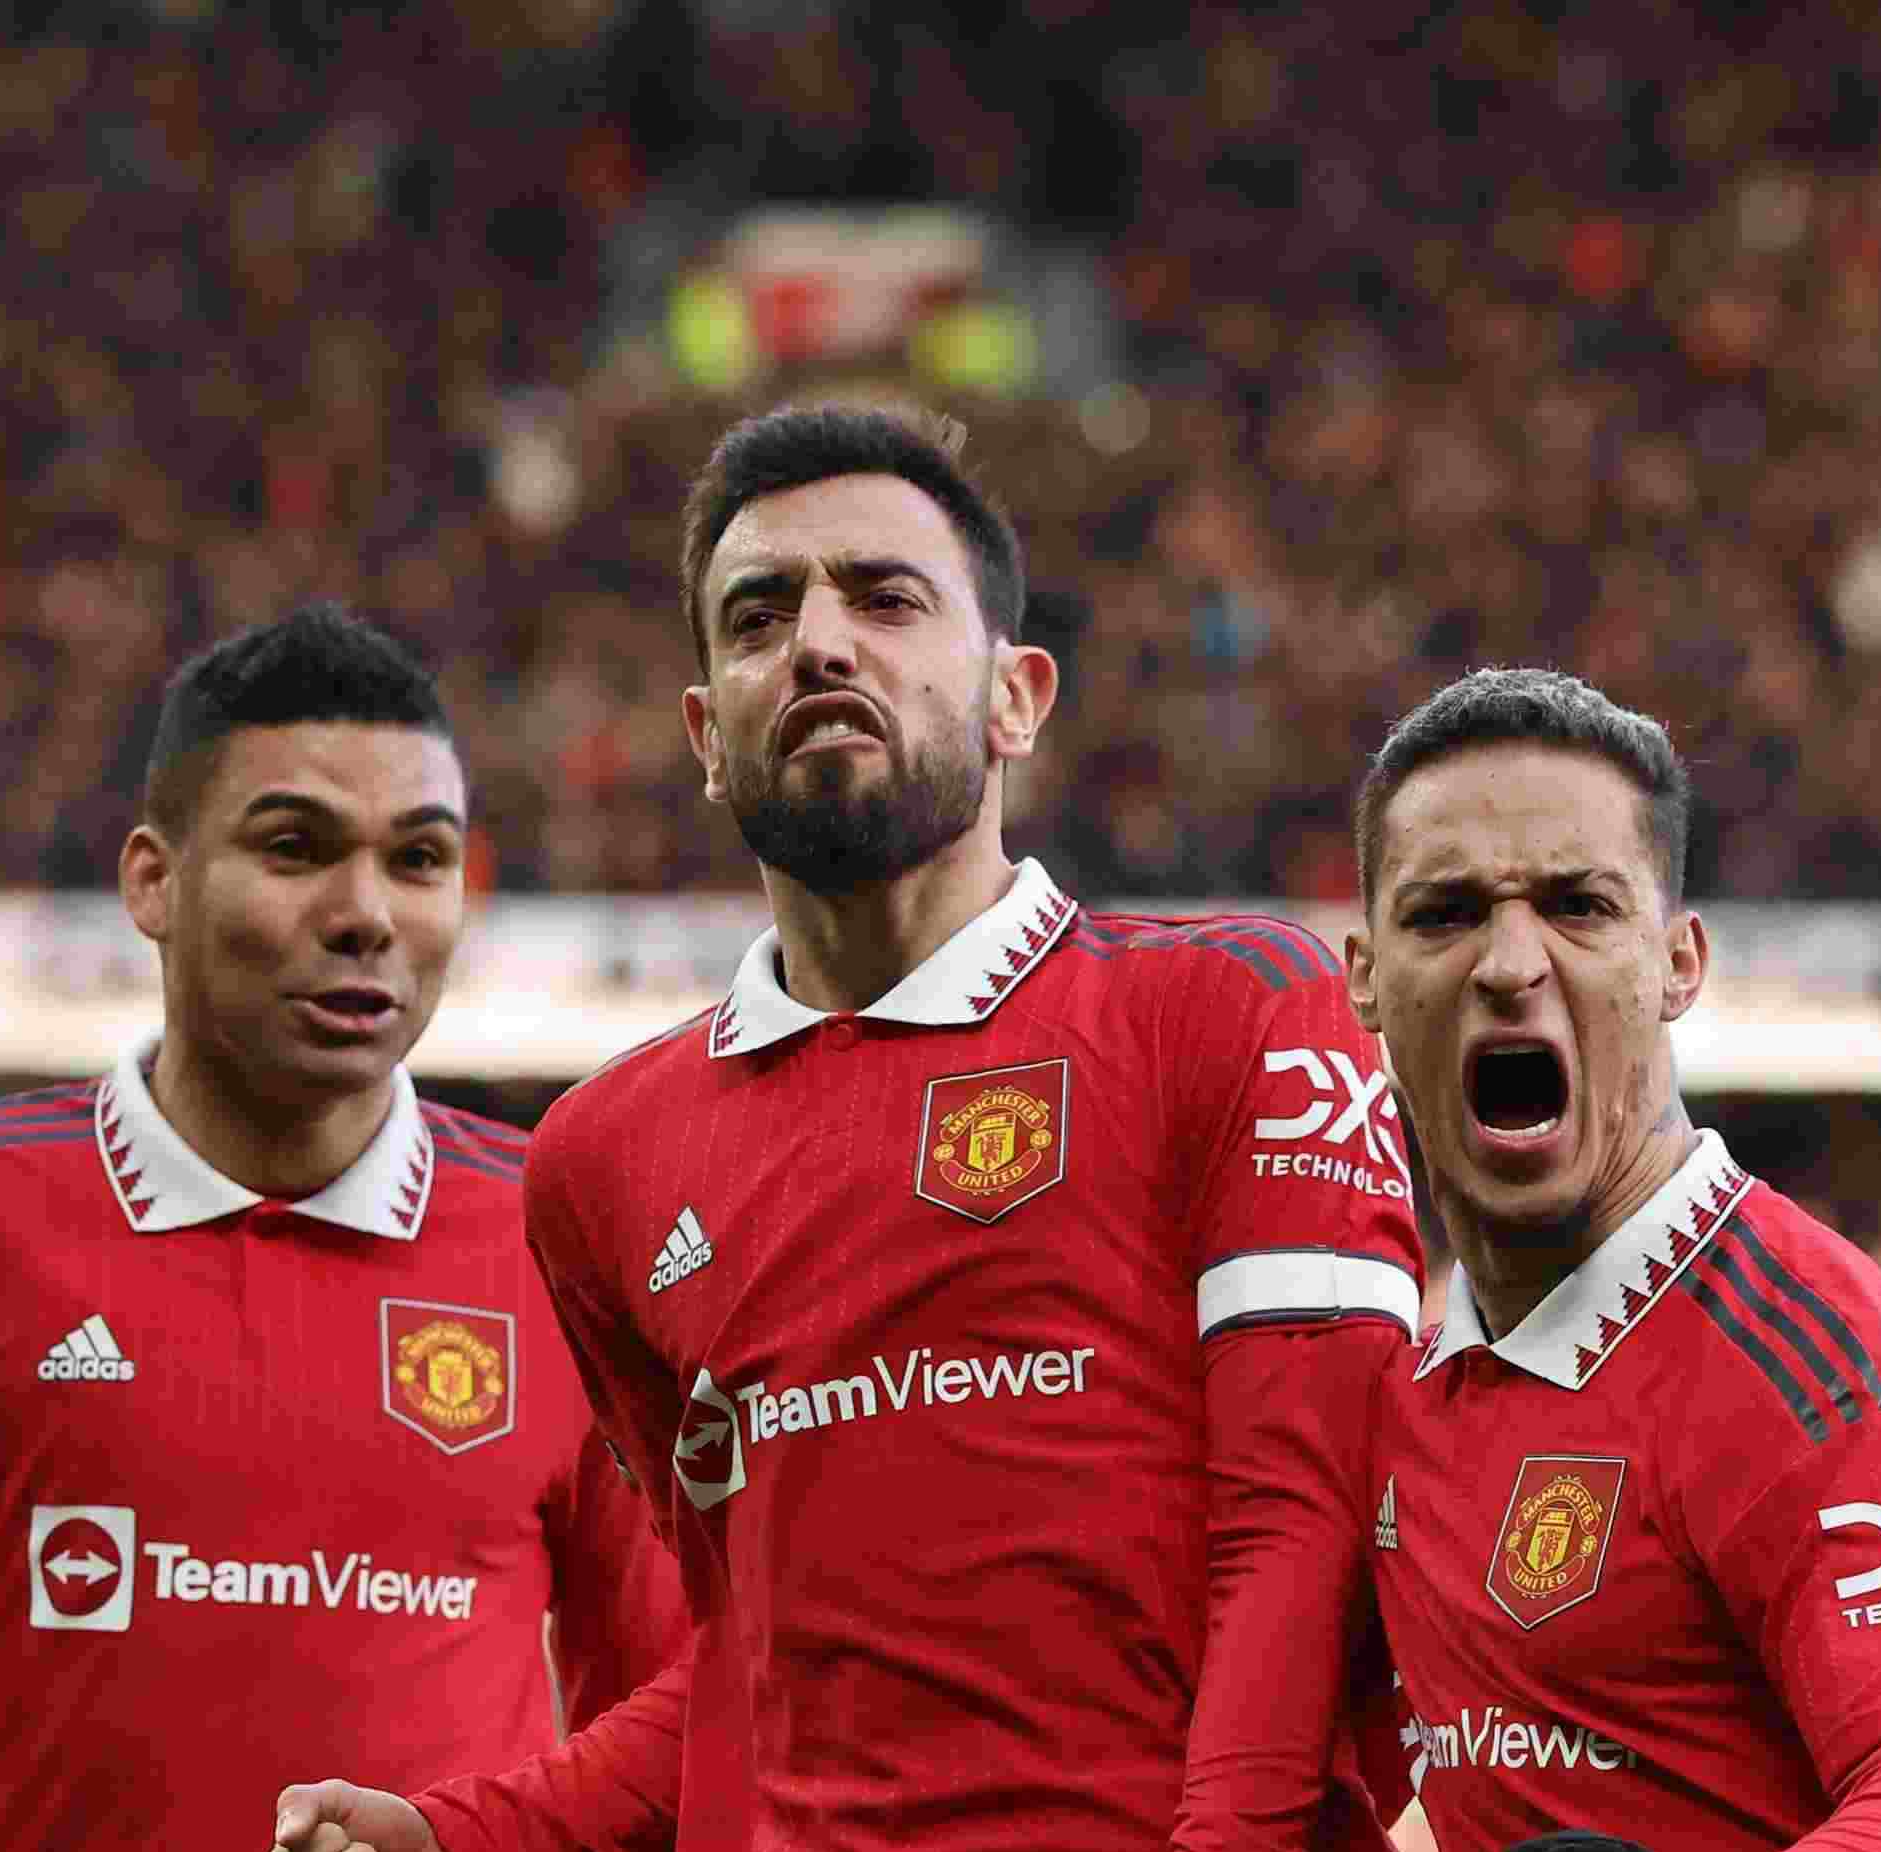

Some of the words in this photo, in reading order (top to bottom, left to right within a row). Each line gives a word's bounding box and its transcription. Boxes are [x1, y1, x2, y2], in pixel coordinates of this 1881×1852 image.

[949, 1094, 1040, 1134] MANCHESTER
[957, 1166, 1023, 1188] UNITED
[1251, 1152, 1414, 1201] TECHNOLO
[648, 1240, 713, 1293] adidas
[38, 1354, 135, 1381] adidas
[736, 1347, 1095, 1444] TeamViewer
[1522, 1483, 1595, 1525] MANCHESTER
[144, 1542, 478, 1620] TeamViewer
[1513, 1567, 1568, 1590] UNITED
